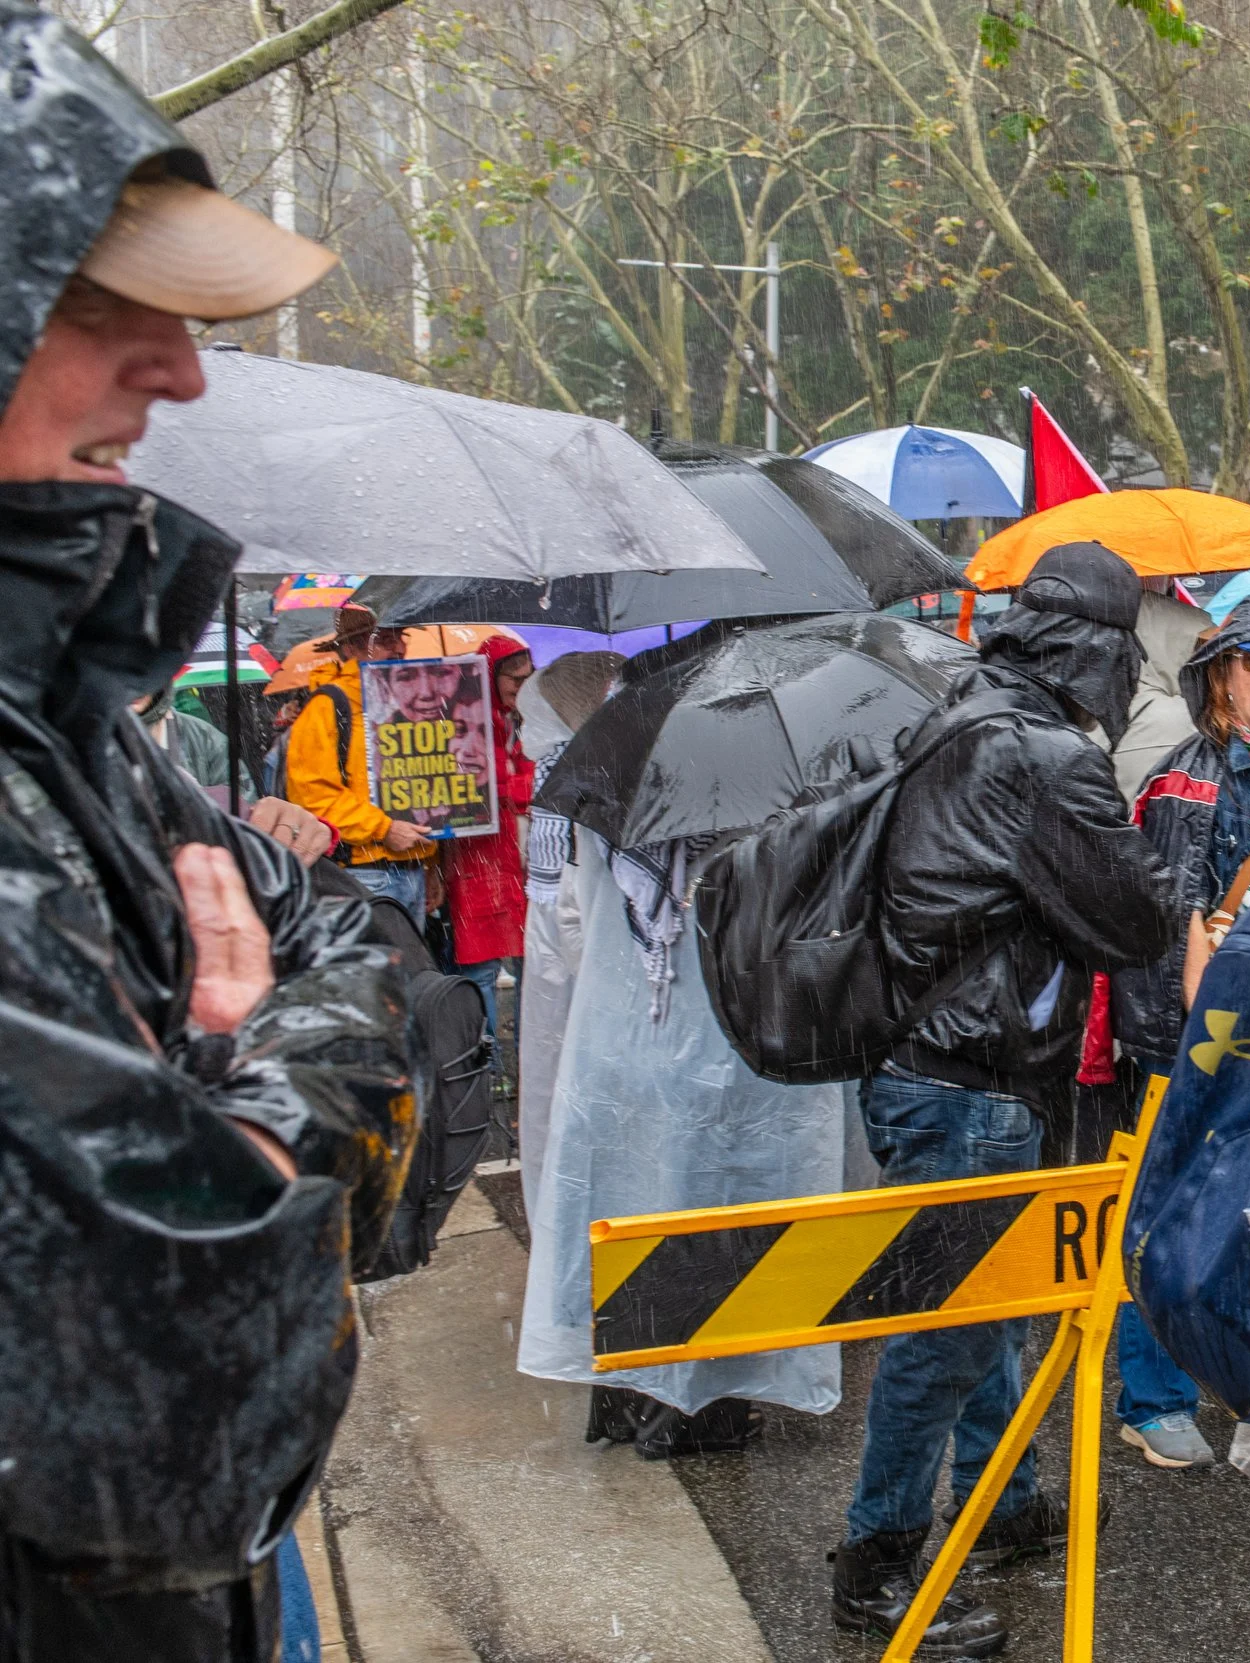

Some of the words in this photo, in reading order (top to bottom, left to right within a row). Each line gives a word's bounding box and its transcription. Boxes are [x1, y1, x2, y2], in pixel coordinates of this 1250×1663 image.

[377, 719, 456, 756] STOP
[381, 753, 457, 778] ARMING
[381, 774, 484, 811] ISRAEL
